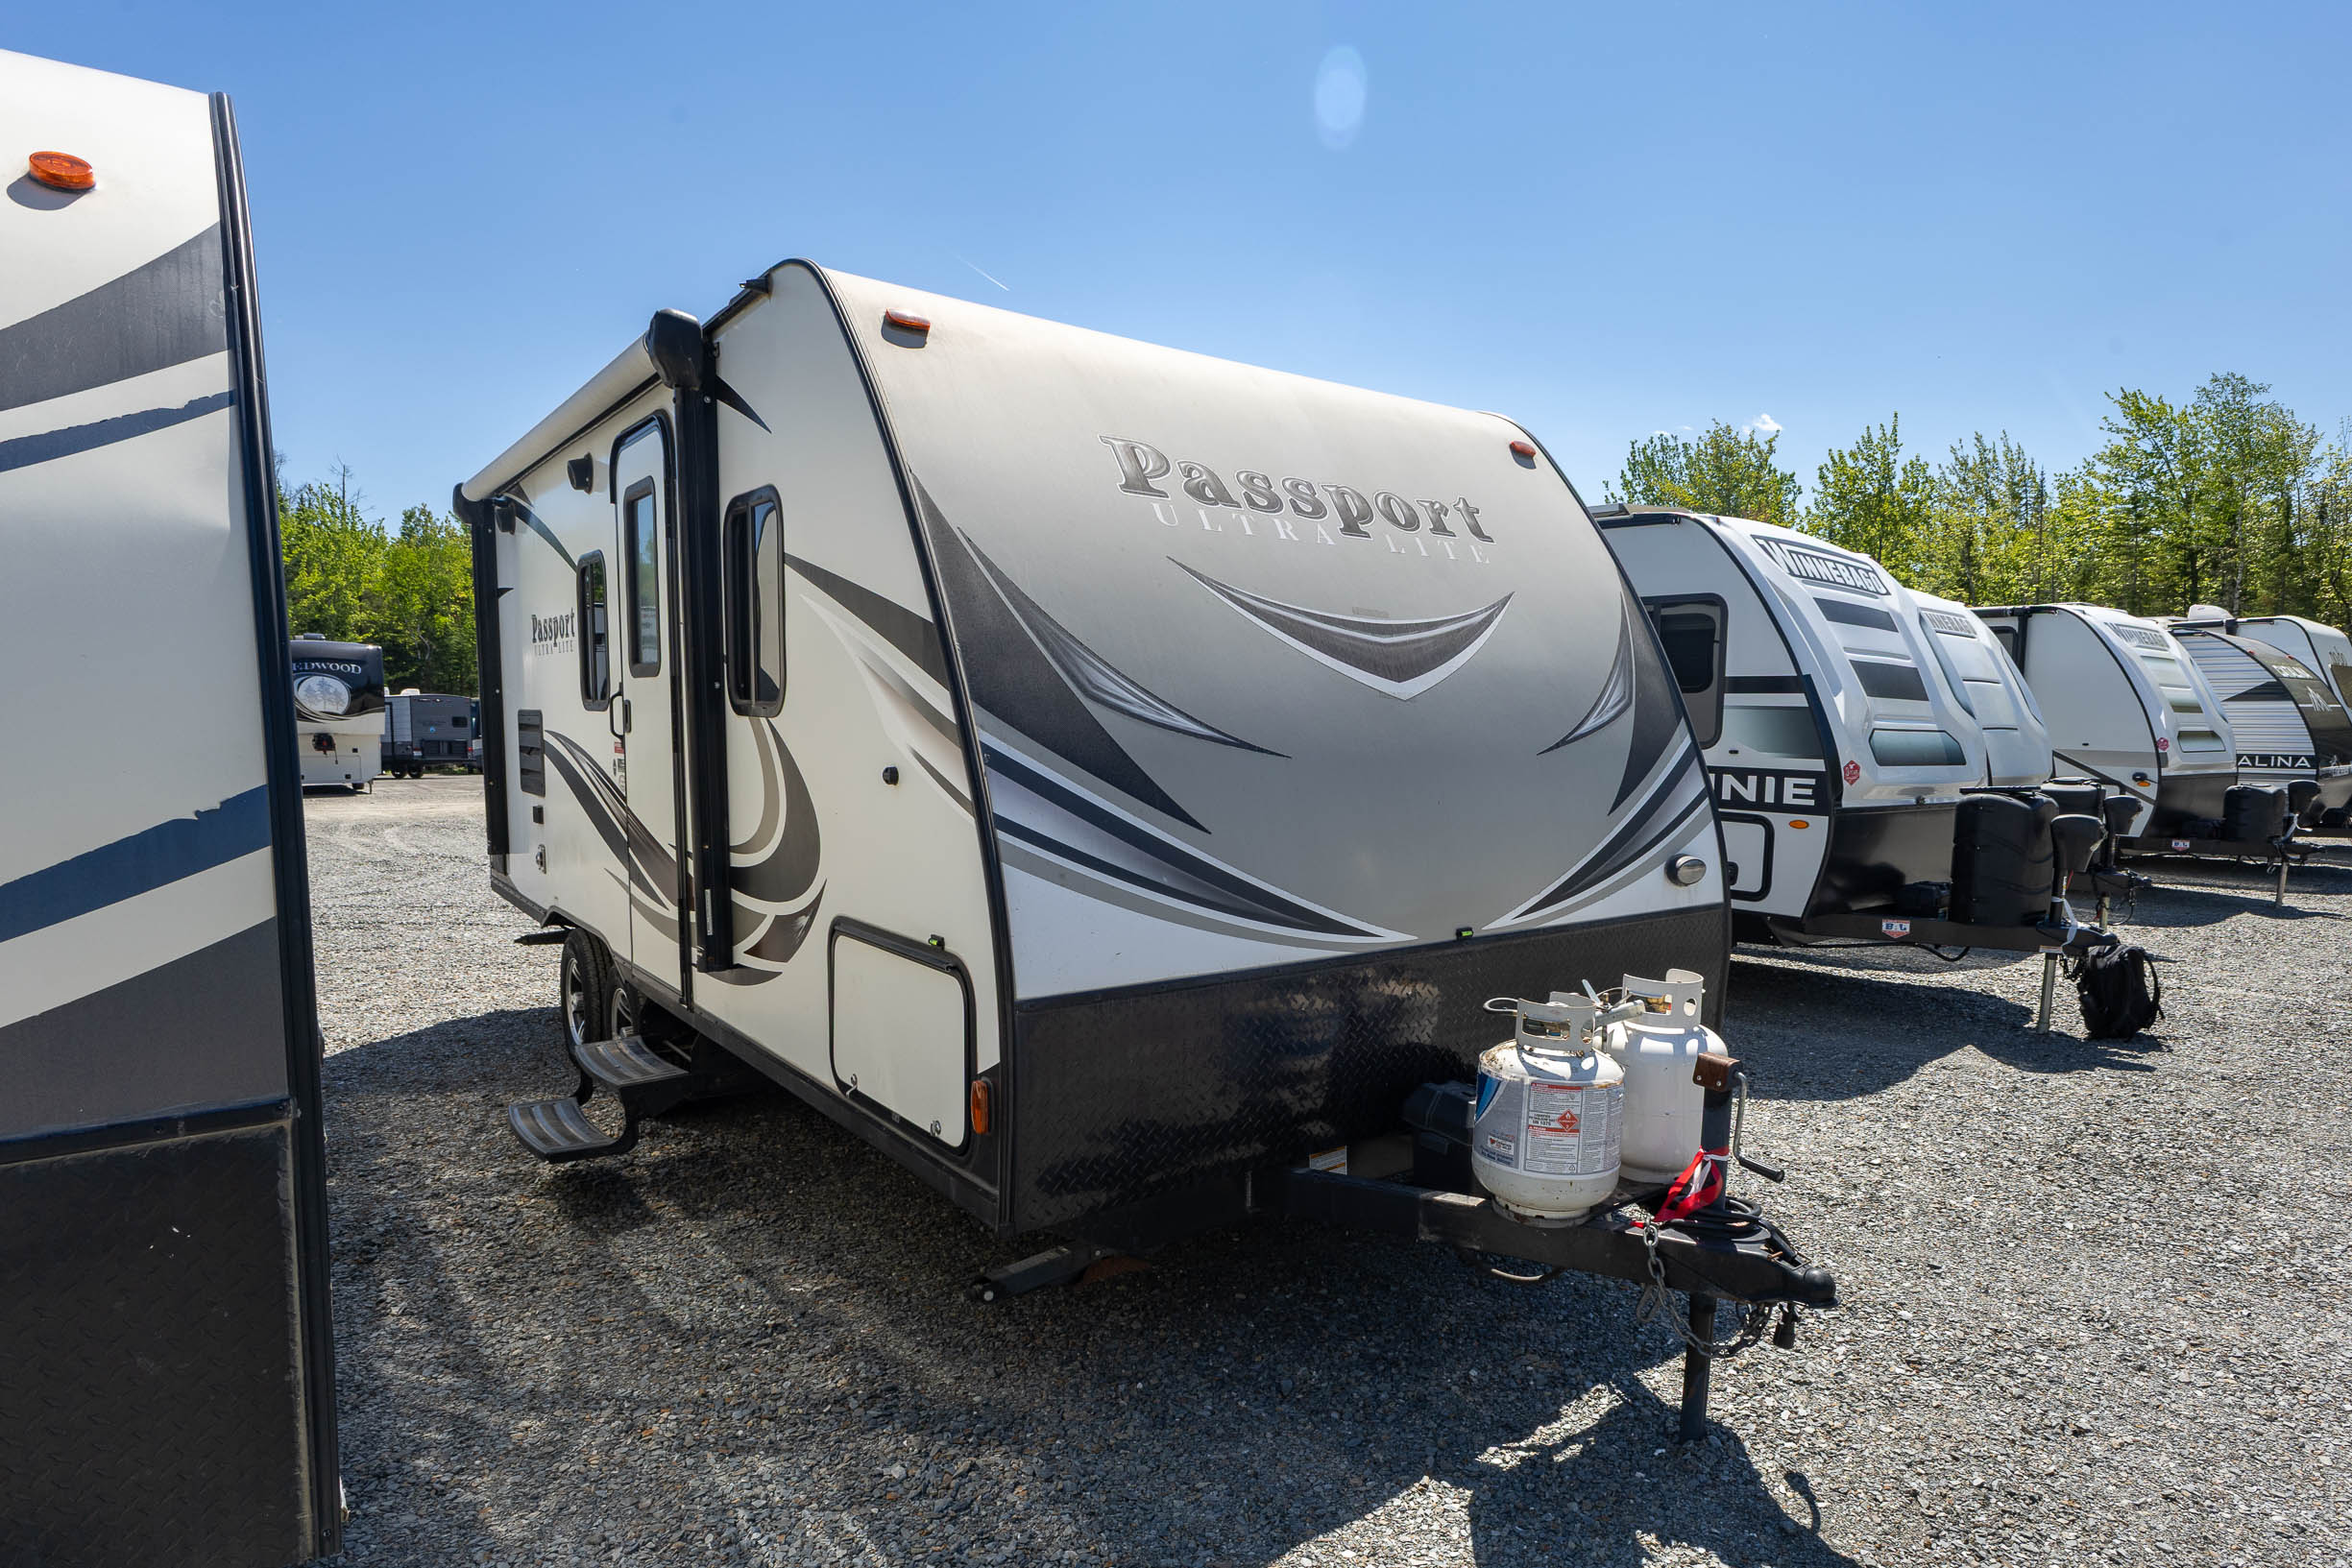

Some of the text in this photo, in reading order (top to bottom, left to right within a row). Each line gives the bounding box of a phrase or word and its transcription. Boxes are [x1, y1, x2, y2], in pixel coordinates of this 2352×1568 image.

[1098, 434, 1495, 543] Passport
[1152, 503, 1490, 565] ULTRA LITE
[1754, 538, 1887, 594] WINNEBAGO
[531, 607, 575, 647] Passport
[1924, 612, 1977, 636] NNEBAGO
[292, 662, 362, 674] EDWOOD
[2238, 755, 2311, 768] ALINA
